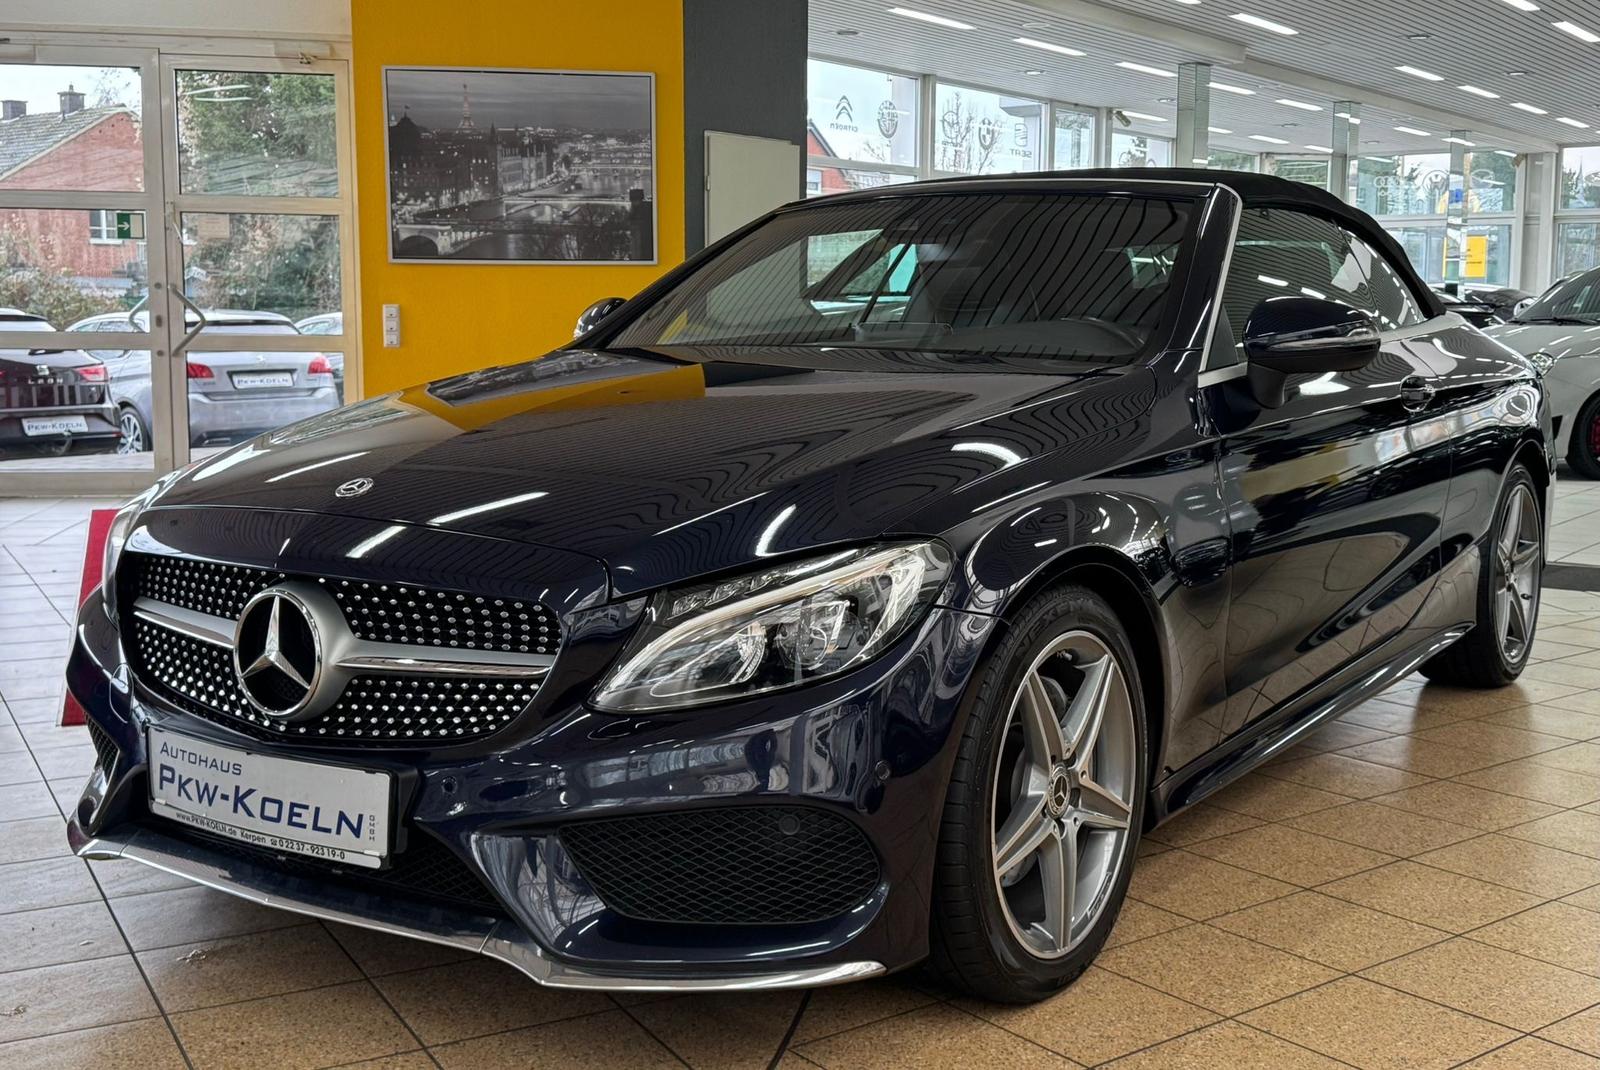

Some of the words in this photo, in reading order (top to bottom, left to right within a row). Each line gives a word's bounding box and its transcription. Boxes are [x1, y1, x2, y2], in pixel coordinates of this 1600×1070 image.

[160, 741, 242, 776] AUTOHAUS
[159, 763, 364, 839] PKW-KOELN
[240, 829, 266, 844] Kerpen
